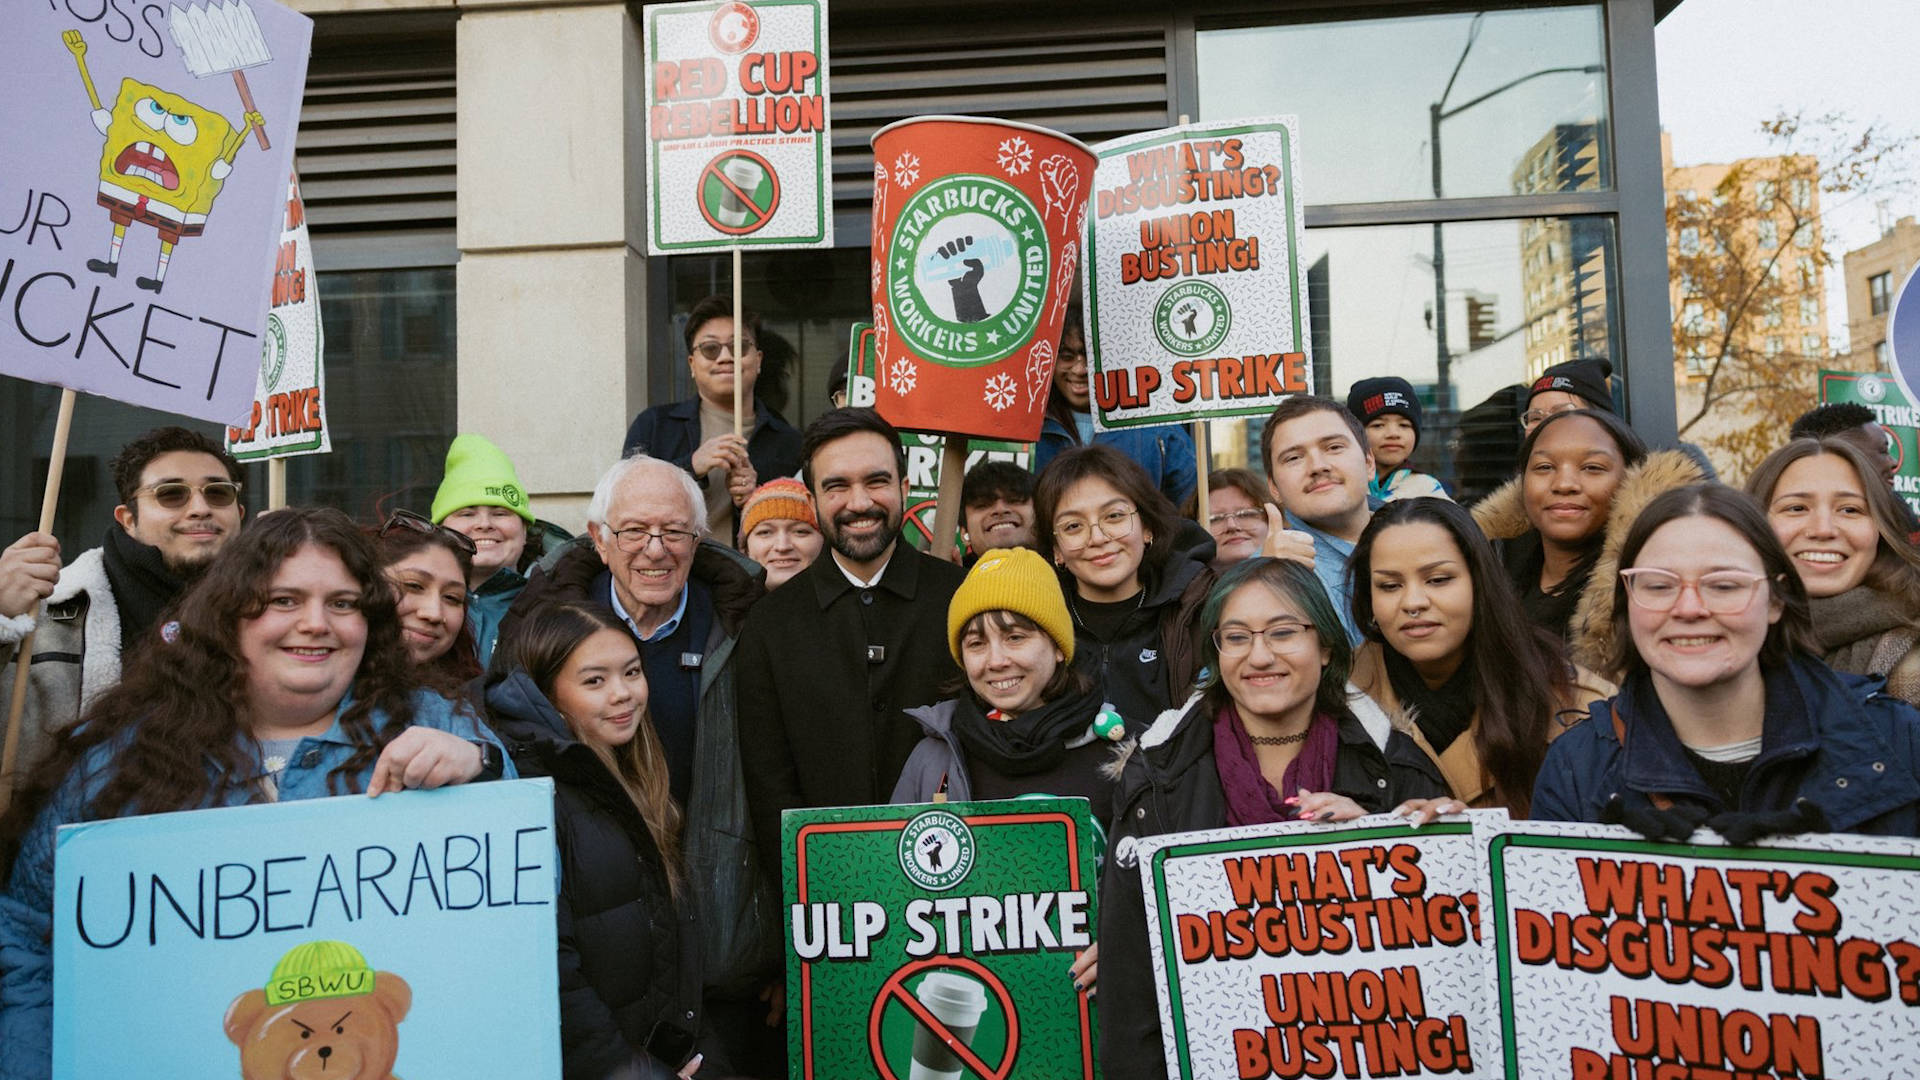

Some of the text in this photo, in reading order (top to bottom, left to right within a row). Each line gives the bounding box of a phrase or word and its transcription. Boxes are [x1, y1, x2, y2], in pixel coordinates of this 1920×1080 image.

[49, 0, 164, 58] OSS
[655, 51, 819, 100] RED CUP
[651, 95, 825, 141] REBELLION
[730, 137, 776, 146] PRACTICE
[778, 136, 813, 144] STRIKE
[1127, 139, 1245, 182] WHAT'S
[1097, 164, 1282, 219] DISGUSTING?
[898, 186, 1028, 251] STARBUCKS
[1140, 209, 1236, 251] UNION
[1122, 237, 1260, 285] BUSTING!
[893, 274, 978, 352] WORKERS
[1002, 245, 1045, 336] UNITED
[1164, 285, 1219, 308] STARBUCKS
[1160, 320, 1193, 351] WORKERS
[1203, 314, 1225, 346] UNITED
[1094, 351, 1307, 411] ULP STRIKE
[265, 387, 322, 439] TRIKE
[1866, 403, 1920, 428] TRIKE
[909, 816, 963, 838] STARBUCKS
[76, 826, 550, 949] UNBEARABLE
[904, 850, 938, 885] WORKERS
[948, 846, 970, 880] UNITED
[1223, 843, 1426, 908] WHAT'S
[1575, 857, 1841, 936] WHAT'S
[791, 890, 1092, 962] ULP STRIKE
[1515, 908, 1920, 1006] DISGUSTING?
[279, 972, 366, 1000] SBWU
[1261, 965, 1427, 1026] UNION
[1233, 1015, 1474, 1080] BUSTING!
[1610, 995, 1825, 1078] UNION
